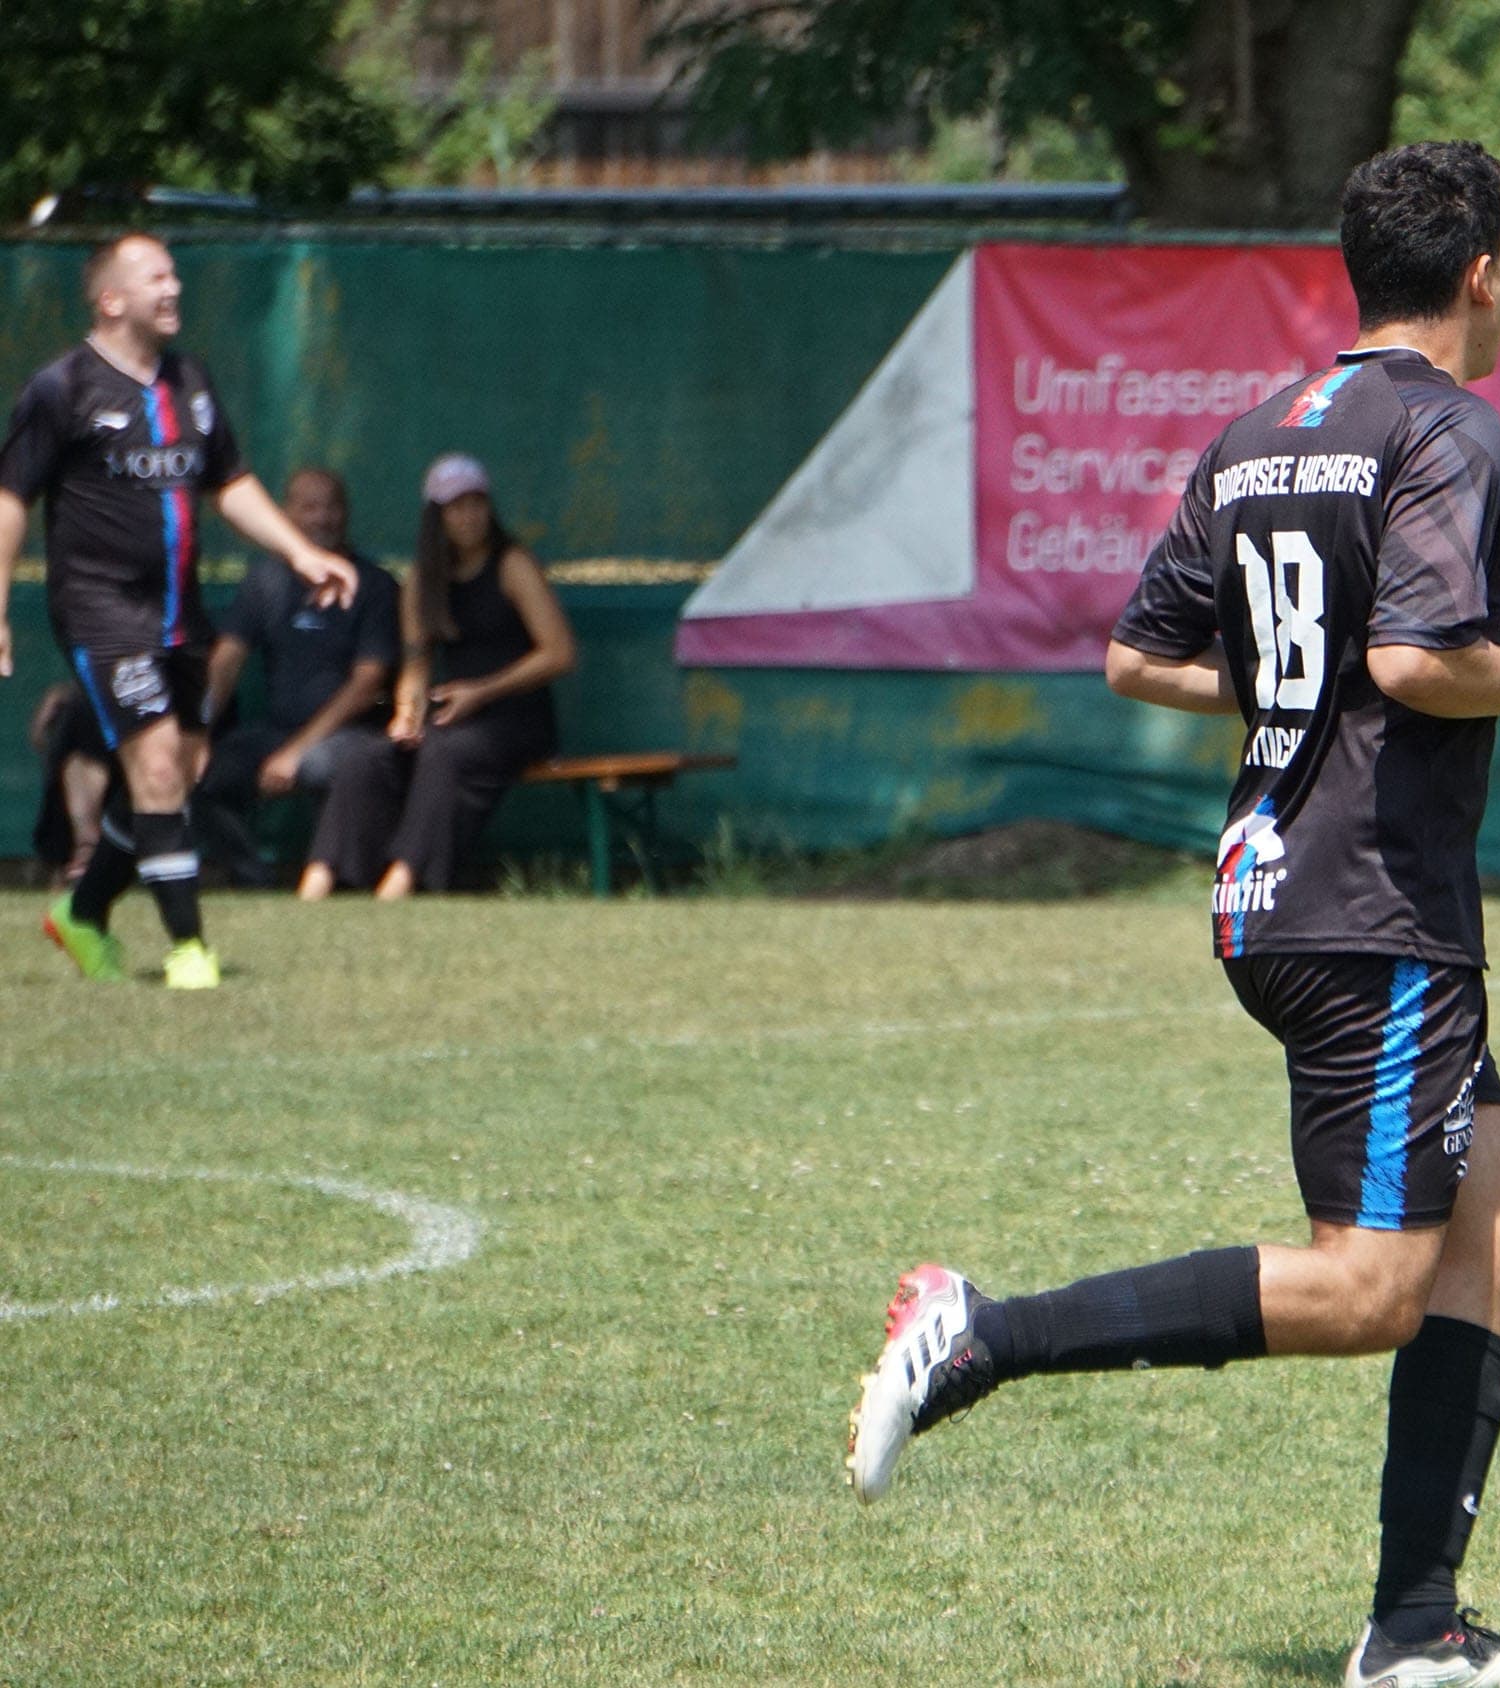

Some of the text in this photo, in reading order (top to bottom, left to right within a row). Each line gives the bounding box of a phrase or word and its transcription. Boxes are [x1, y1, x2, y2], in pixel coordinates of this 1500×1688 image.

[1011, 432, 1201, 494] Service
[1213, 454, 1378, 512] BODENSEE KICKERS
[1235, 530, 1326, 710] 18
